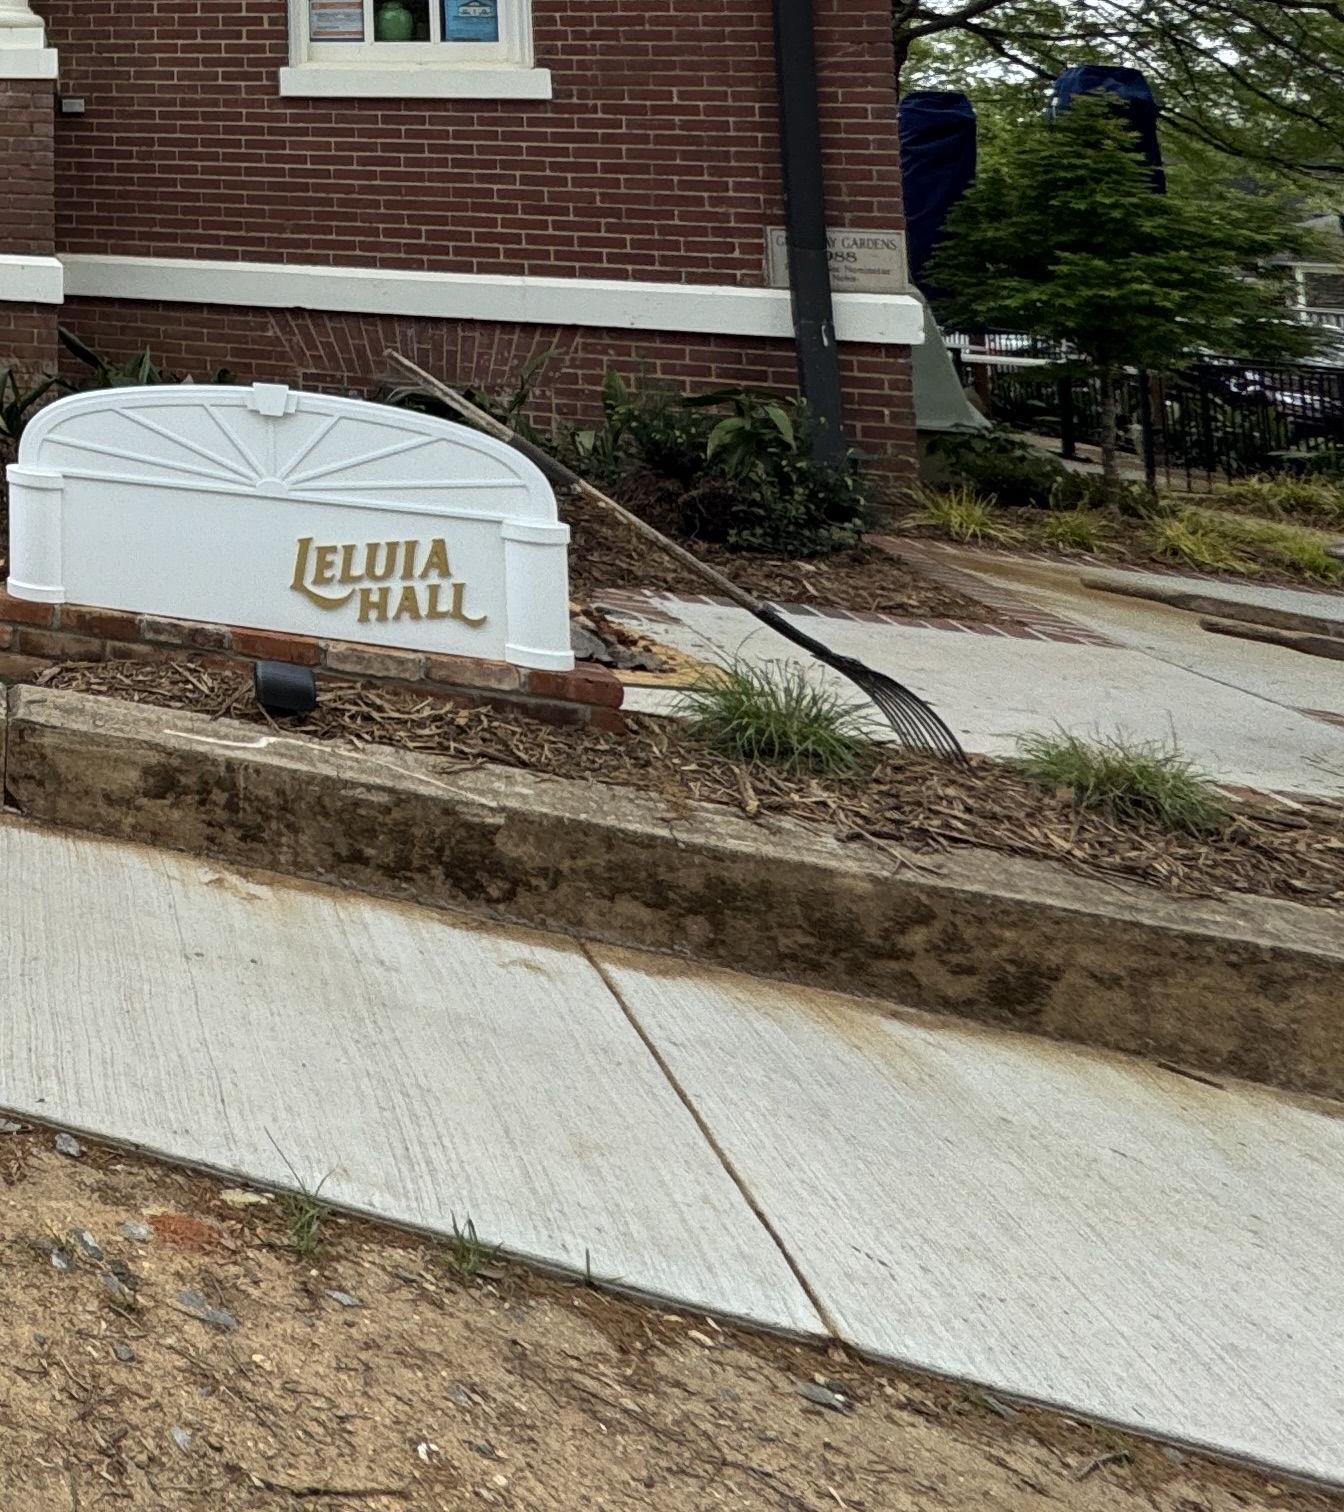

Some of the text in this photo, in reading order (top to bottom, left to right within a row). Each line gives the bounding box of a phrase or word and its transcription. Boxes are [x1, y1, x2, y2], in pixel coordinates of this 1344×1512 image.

[842, 238, 897, 251] GARDENS
[290, 537, 452, 610] LELUIA
[357, 582, 487, 627] HALL
